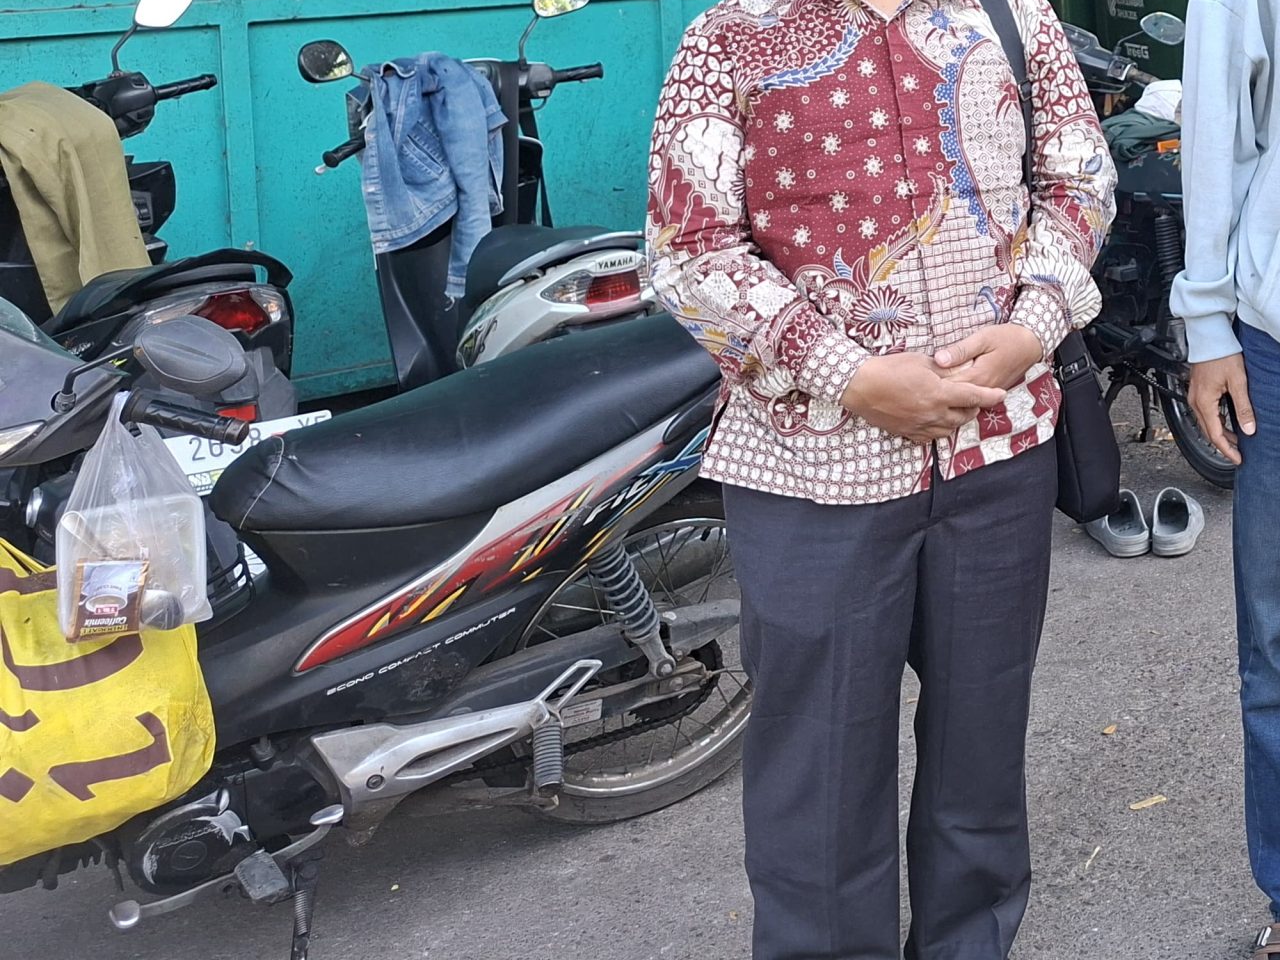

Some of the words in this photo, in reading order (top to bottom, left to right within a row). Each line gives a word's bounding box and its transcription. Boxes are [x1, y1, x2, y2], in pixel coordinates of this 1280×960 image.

[598, 256, 633, 269] YAMAHA
[84, 616, 127, 626] Coffeemix
[326, 672, 375, 696] ECONO
[444, 606, 516, 645] COMMUTER
